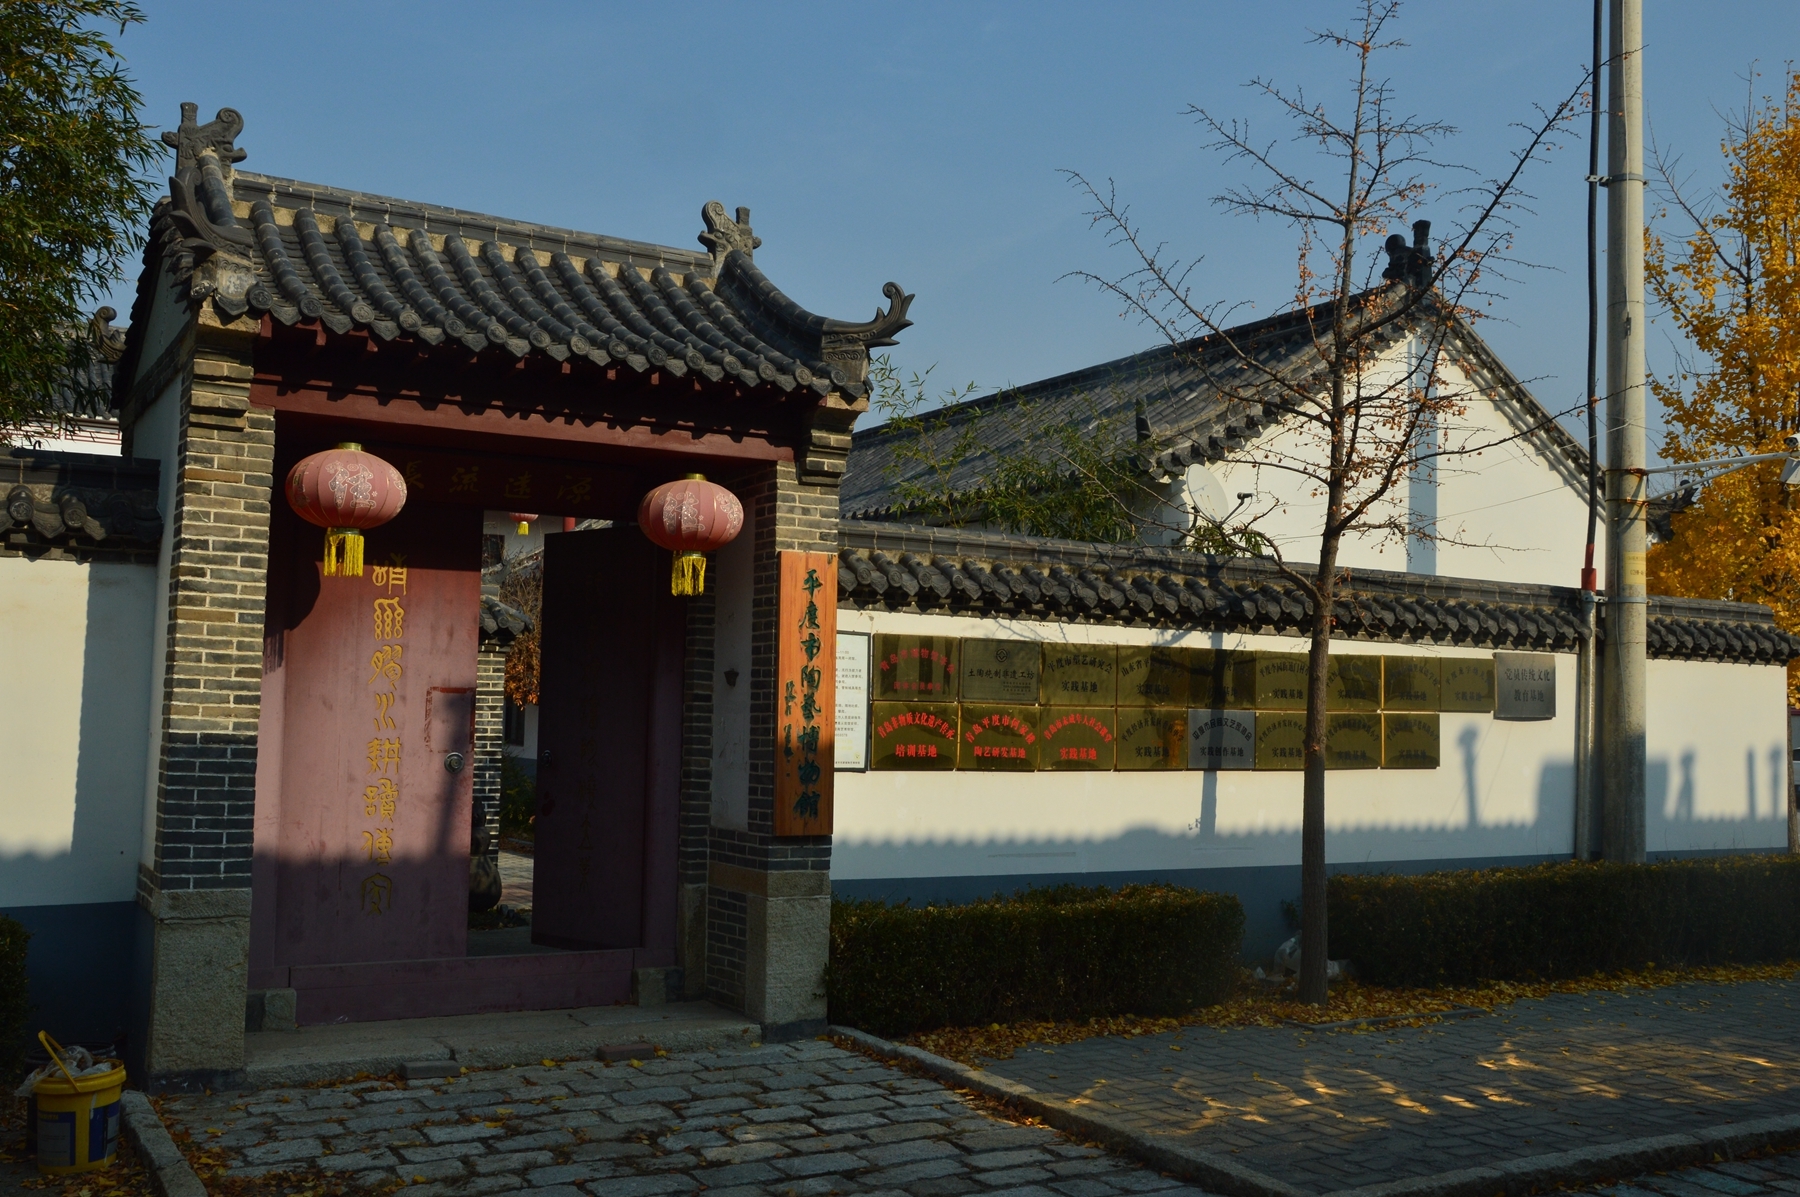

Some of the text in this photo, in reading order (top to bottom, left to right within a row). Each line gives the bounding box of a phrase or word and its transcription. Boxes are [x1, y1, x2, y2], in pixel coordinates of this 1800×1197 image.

[1505, 668, 1550, 682] 党员传统文化
[1061, 680, 1098, 693] 实践基地
[1272, 687, 1304, 700] 实践基地
[1454, 690, 1482, 702] 实践基地
[1513, 689, 1544, 702] 教育基地
[877, 711, 956, 740] 青岛非物质文化遗产传承
[1043, 713, 1113, 744] 青岛市未成年人社会课堂
[895, 744, 938, 758] 培训基地
[973, 746, 1026, 759] 陶艺研发基地
[1060, 747, 1097, 760] 实践基地
[1135, 745, 1170, 758] 实践基地
[1199, 746, 1244, 758] 实践创作基地
[1272, 746, 1303, 758] 实践基地
